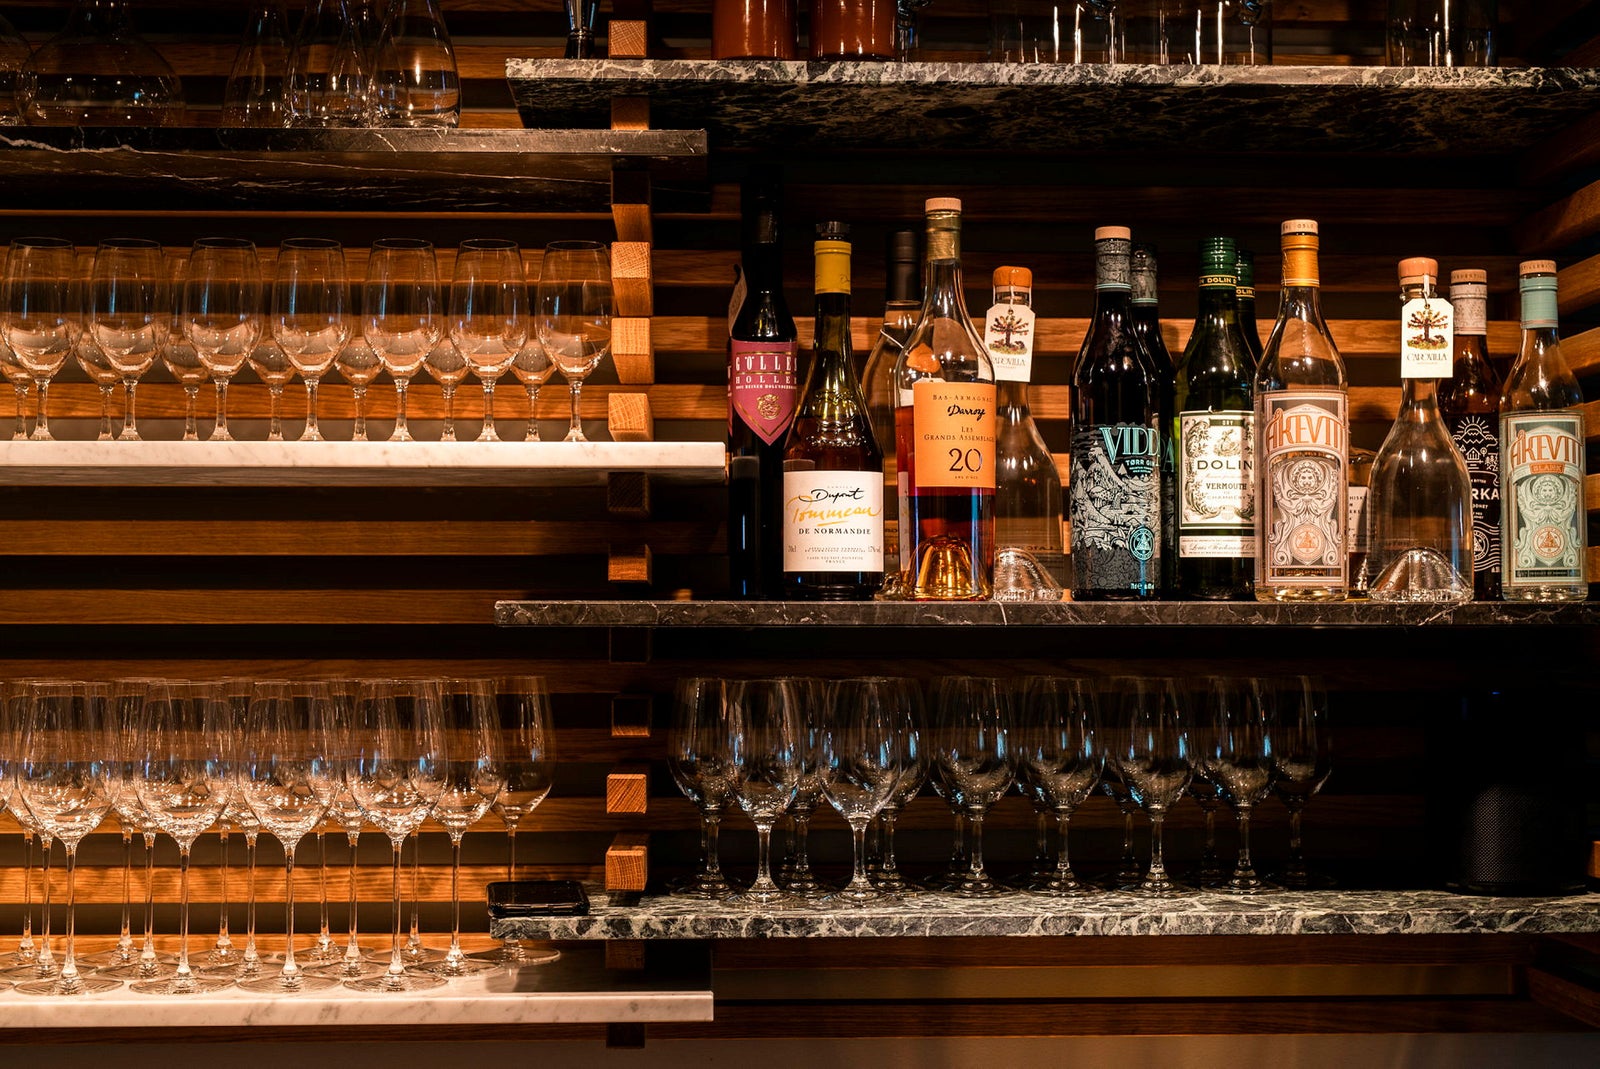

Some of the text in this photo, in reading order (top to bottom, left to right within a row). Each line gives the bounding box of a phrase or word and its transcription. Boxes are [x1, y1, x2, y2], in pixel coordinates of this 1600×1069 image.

[948, 448, 983, 473] 20
[1197, 460, 1253, 470] DOLIN
[799, 488, 865, 503] Dupont
